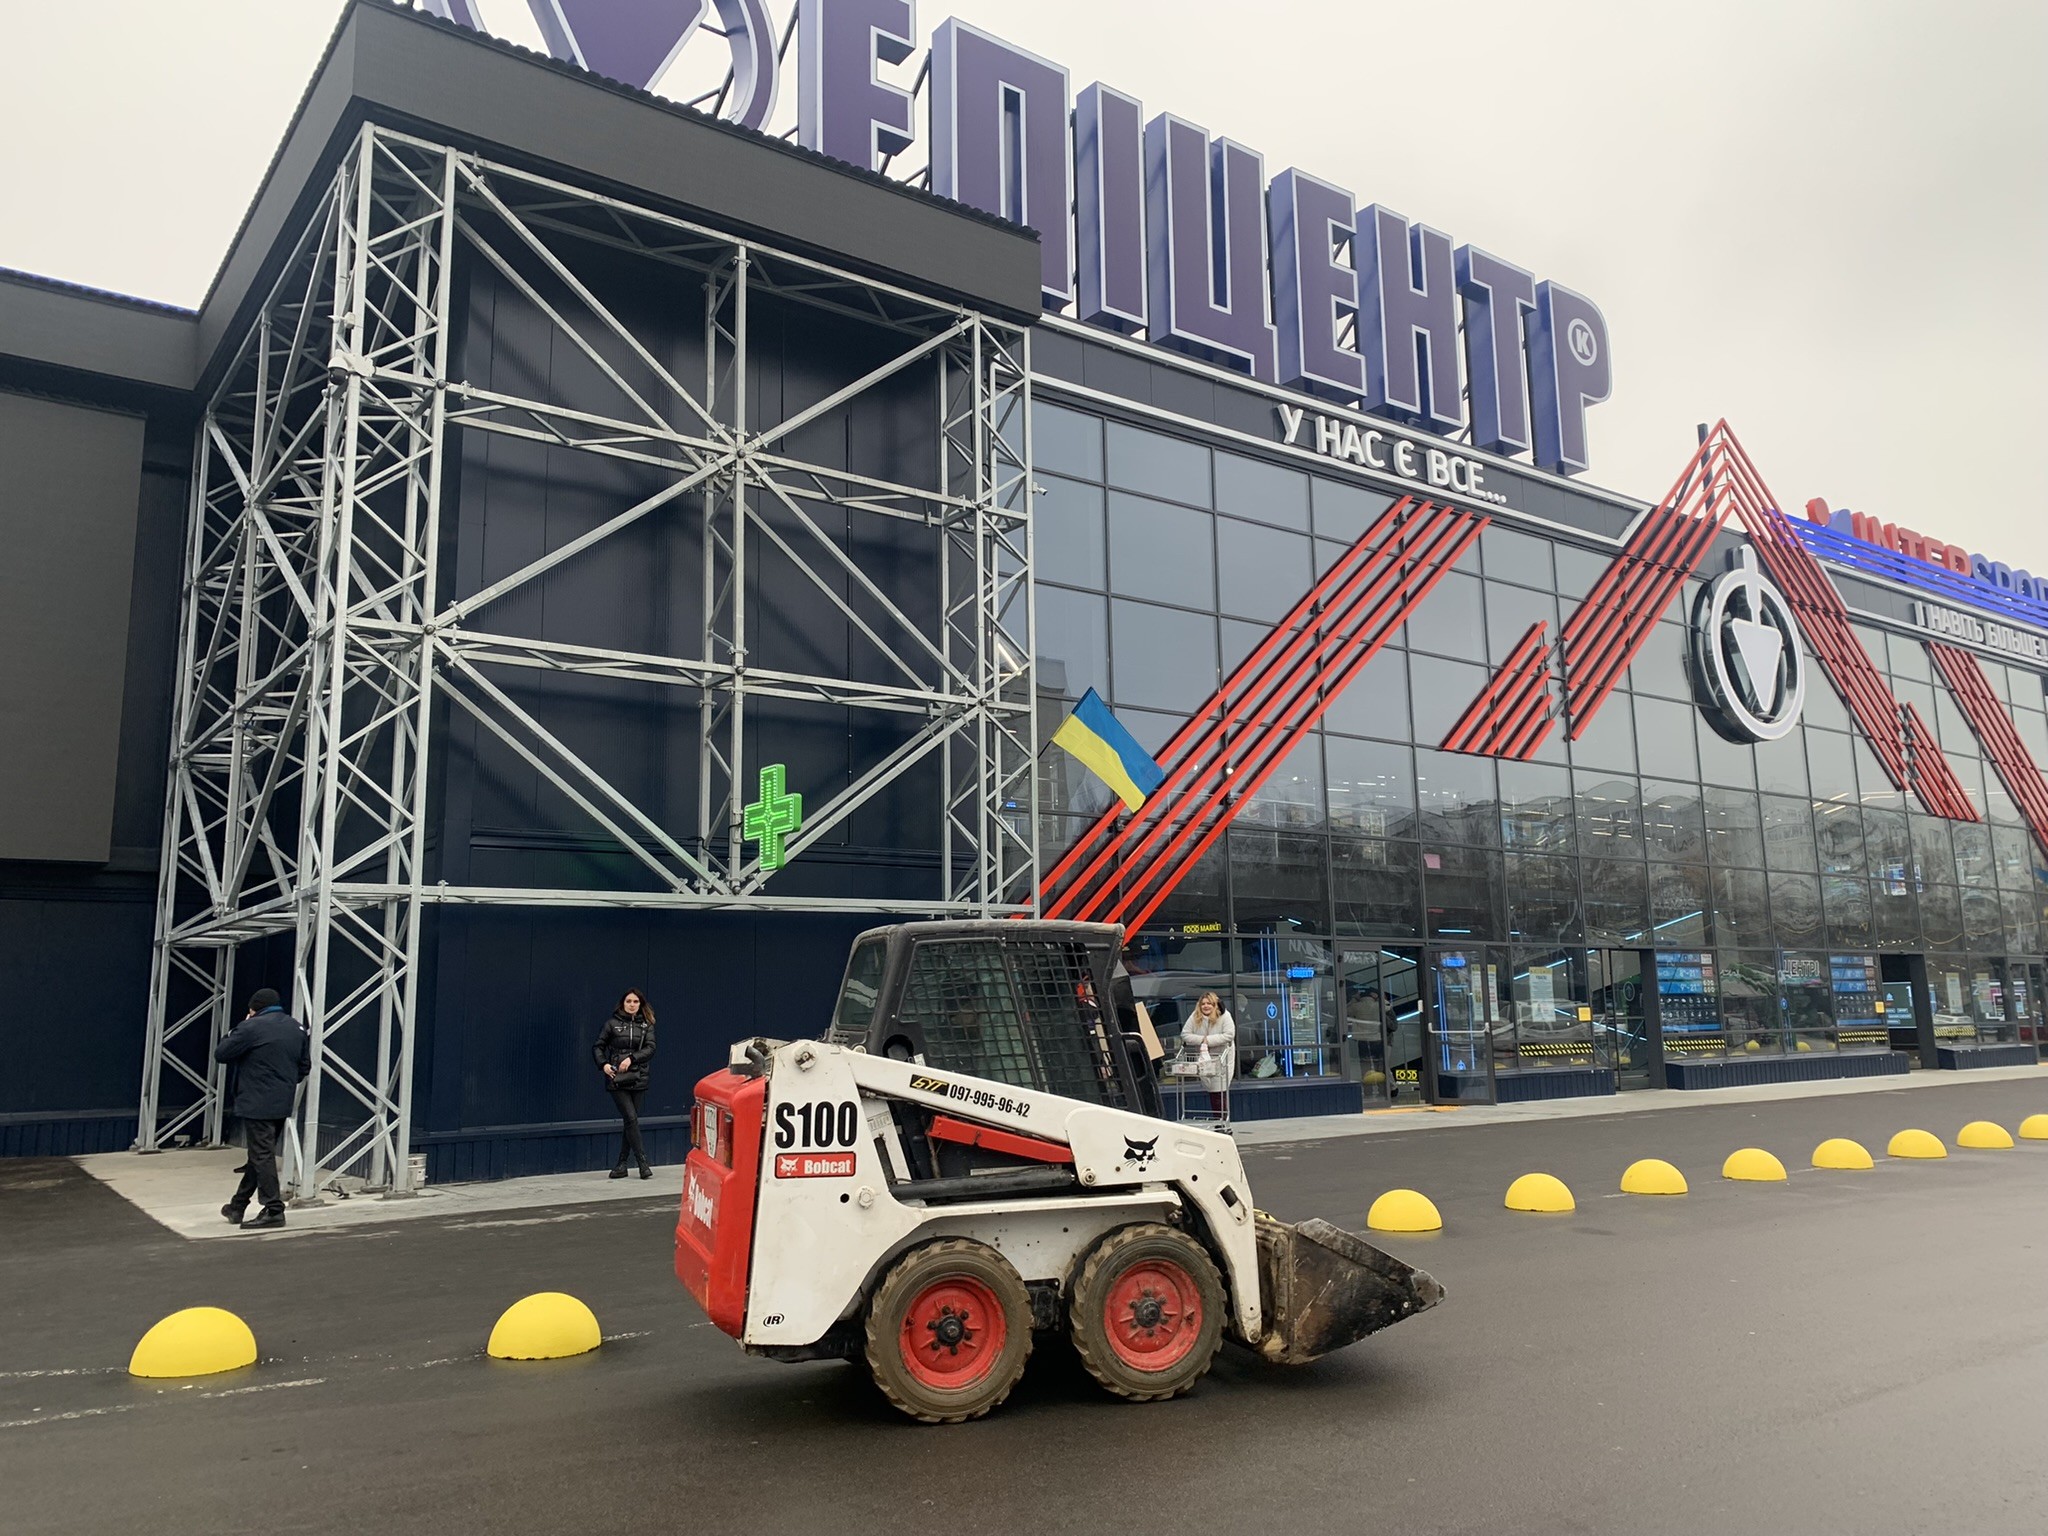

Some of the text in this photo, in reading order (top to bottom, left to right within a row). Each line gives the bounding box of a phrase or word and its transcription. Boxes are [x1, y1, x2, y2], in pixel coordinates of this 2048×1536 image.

[1277, 403, 1304, 445] У
[1315, 415, 1386, 468] НАС
[1393, 439, 1418, 478] Є
[1926, 603, 1984, 643] НАВІТЬ
[1183, 924, 1200, 934] FOOD
[949, 1084, 1031, 1118] 097-995-96-42
[775, 1101, 857, 1149] S100
[804, 1159, 852, 1175] Bobcat
